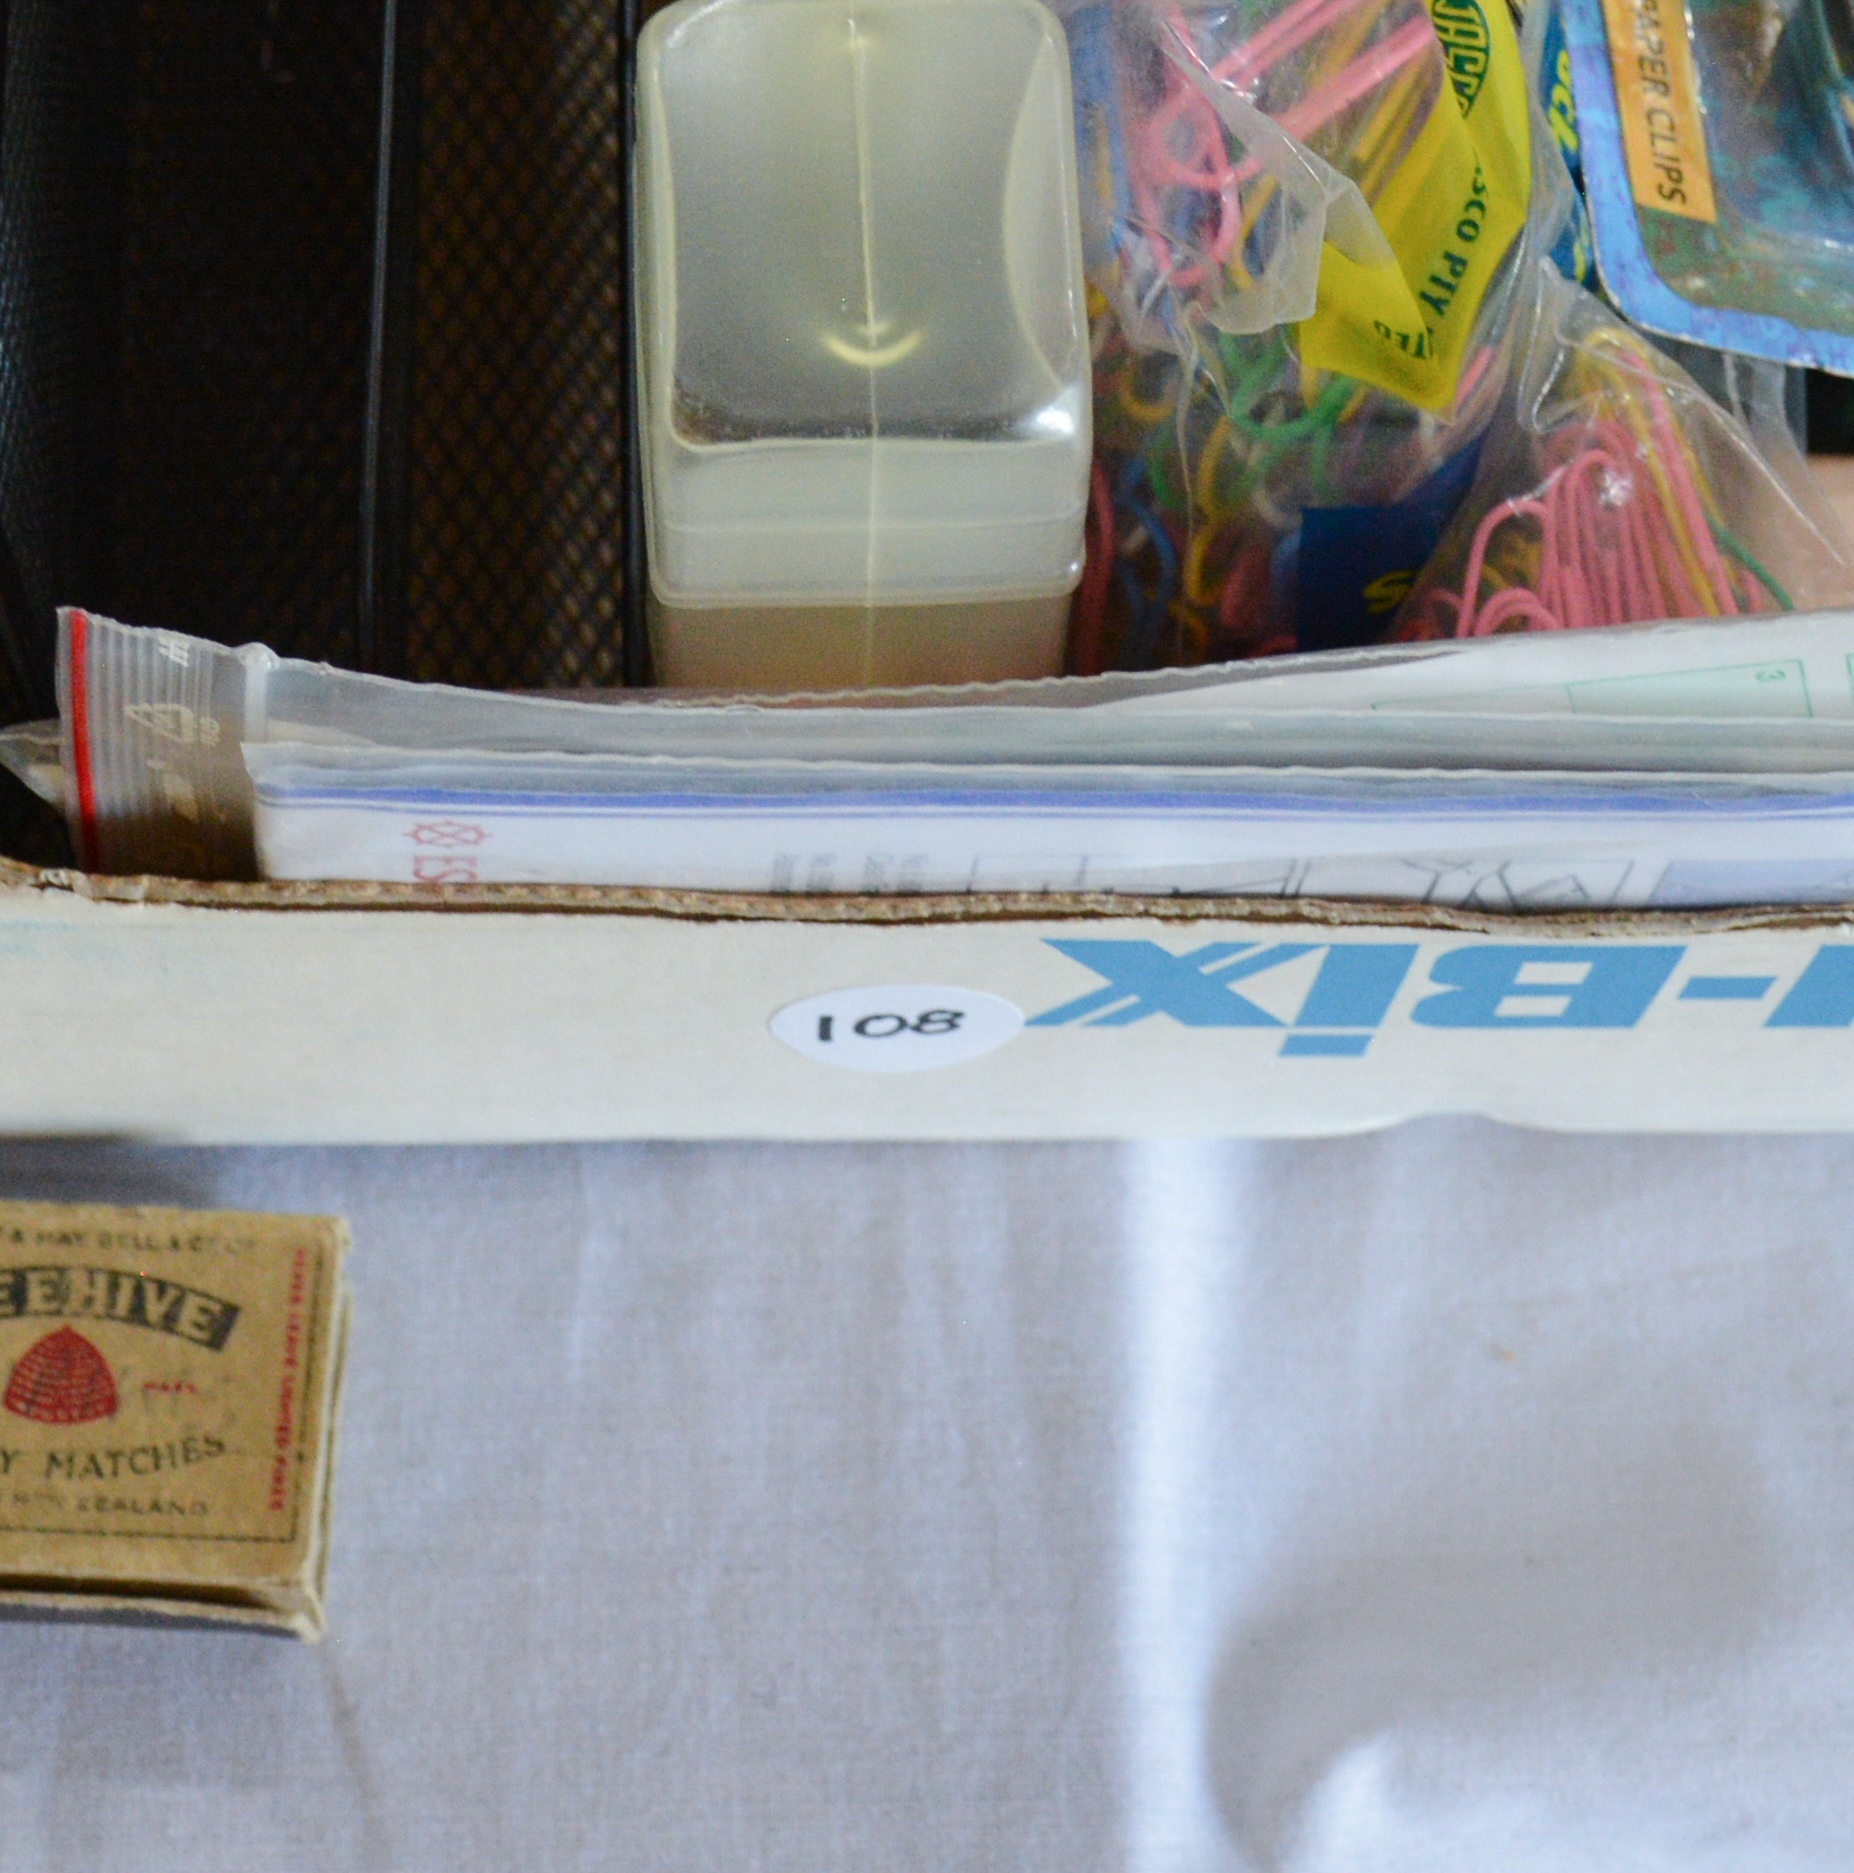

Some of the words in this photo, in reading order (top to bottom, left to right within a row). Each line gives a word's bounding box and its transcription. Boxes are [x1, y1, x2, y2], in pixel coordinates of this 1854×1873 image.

[1646, 107, 1688, 205] CLIPS
[1419, 250, 1469, 318] PTY
[817, 1008, 966, 1042] 108
[45, 1434, 227, 1480] MATCHES
[76, 1495, 210, 1517] ZEALAND
